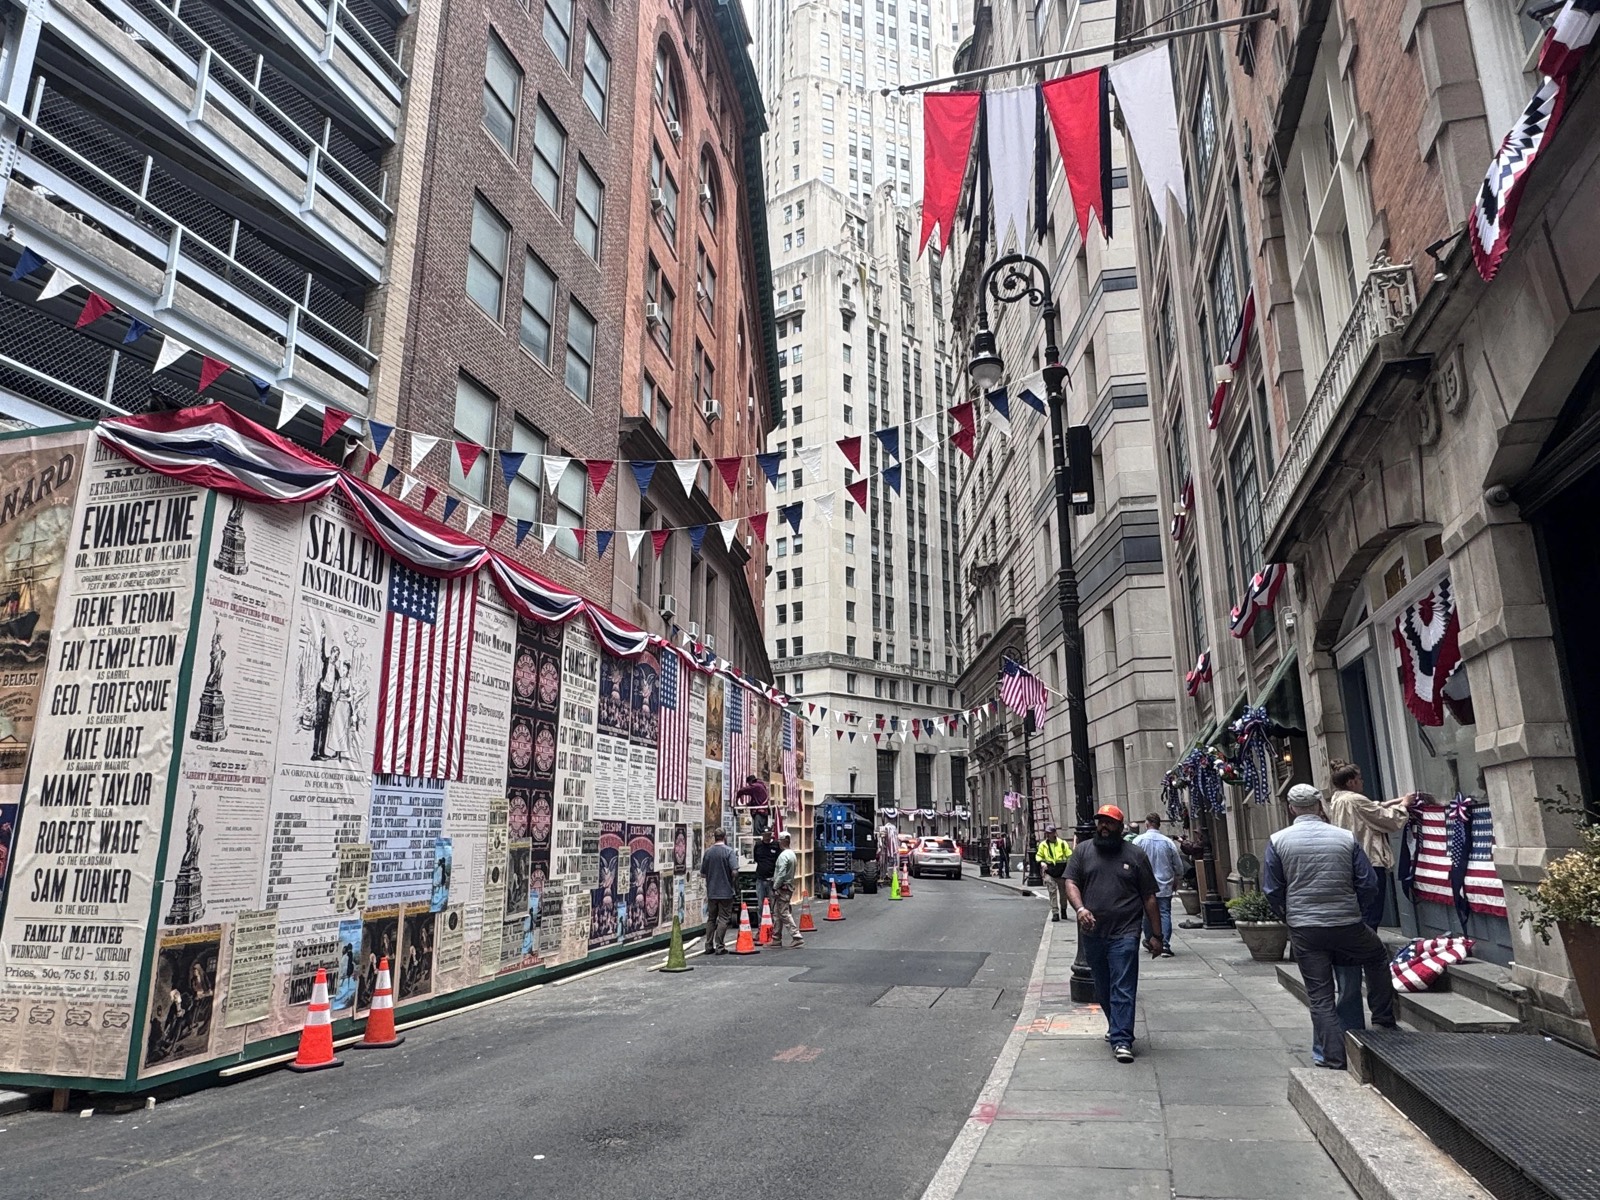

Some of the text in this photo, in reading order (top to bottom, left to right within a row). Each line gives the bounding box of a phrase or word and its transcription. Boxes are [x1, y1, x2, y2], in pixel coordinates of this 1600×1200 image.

[89, 478, 143, 496] EXTRAVAGANZA
[79, 496, 198, 550] EVANGELINE
[94, 552, 111, 567] THE
[114, 549, 141, 565] BELLE
[145, 546, 158, 562] OF
[160, 544, 191, 561] ACADIA
[306, 514, 384, 586] SEALED
[87, 582, 100, 590] TEXT
[100, 581, 108, 590] BY
[147, 577, 171, 586] GOODWIN
[104, 572, 120, 581] MUSIC
[121, 572, 128, 580] BY
[139, 570, 160, 578] EDWARD
[219, 574, 240, 585] Orders
[241, 580, 268, 594] Received
[302, 561, 383, 613] INSTRUCTIONS
[233, 592, 267, 608] MODEL
[73, 591, 176, 628] IRENE VERONA
[97, 625, 142, 636] AS EVANGELINE
[59, 635, 178, 672] FAY TEMPLETON
[2, 672, 39, 688] BELFAST.
[97, 670, 130, 680] AS GABRIEL
[469, 671, 511, 690] GIC LANTERN
[51, 680, 172, 716] GEO. FORTESCUE
[86, 715, 128, 725] AS CATHERINE
[63, 727, 102, 761] KATE
[196, 744, 218, 752] Orders
[220, 747, 247, 755] Received
[66, 760, 130, 772] AS RUDOLPH MAURICE
[210, 761, 248, 770] MODEL
[291, 769, 320, 779] ORIGINAL
[321, 772, 344, 782] COMEDY
[345, 774, 364, 783] DRAMA
[40, 772, 153, 808] MAMIE TAYLOR
[304, 780, 344, 790] IN FOUR ACTS
[290, 794, 355, 805] CAST OF CHARACTERS
[374, 795, 386, 805] JACK
[387, 796, 402, 806] POTTS
[71, 808, 114, 818] AS THE QUEEN
[478, 814, 487, 822] SIX
[601, 822, 622, 832] CELSIOR
[630, 826, 652, 835] EXCELSIOR
[34, 820, 144, 854] ROBERT WADE
[57, 856, 112, 866] AS THE HEADSMAN
[31, 868, 132, 904] SAM TURNER
[54, 904, 99, 916] AS THE HEIFER
[23, 924, 124, 944] FAMILY MATINEE
[10, 944, 132, 962] WEDNESDAY SATURDAY
[295, 942, 340, 958] COMING!
[234, 953, 274, 965] STATUARY
[4, 966, 131, 982] Prices, 50c, 75c $1, $1.50
